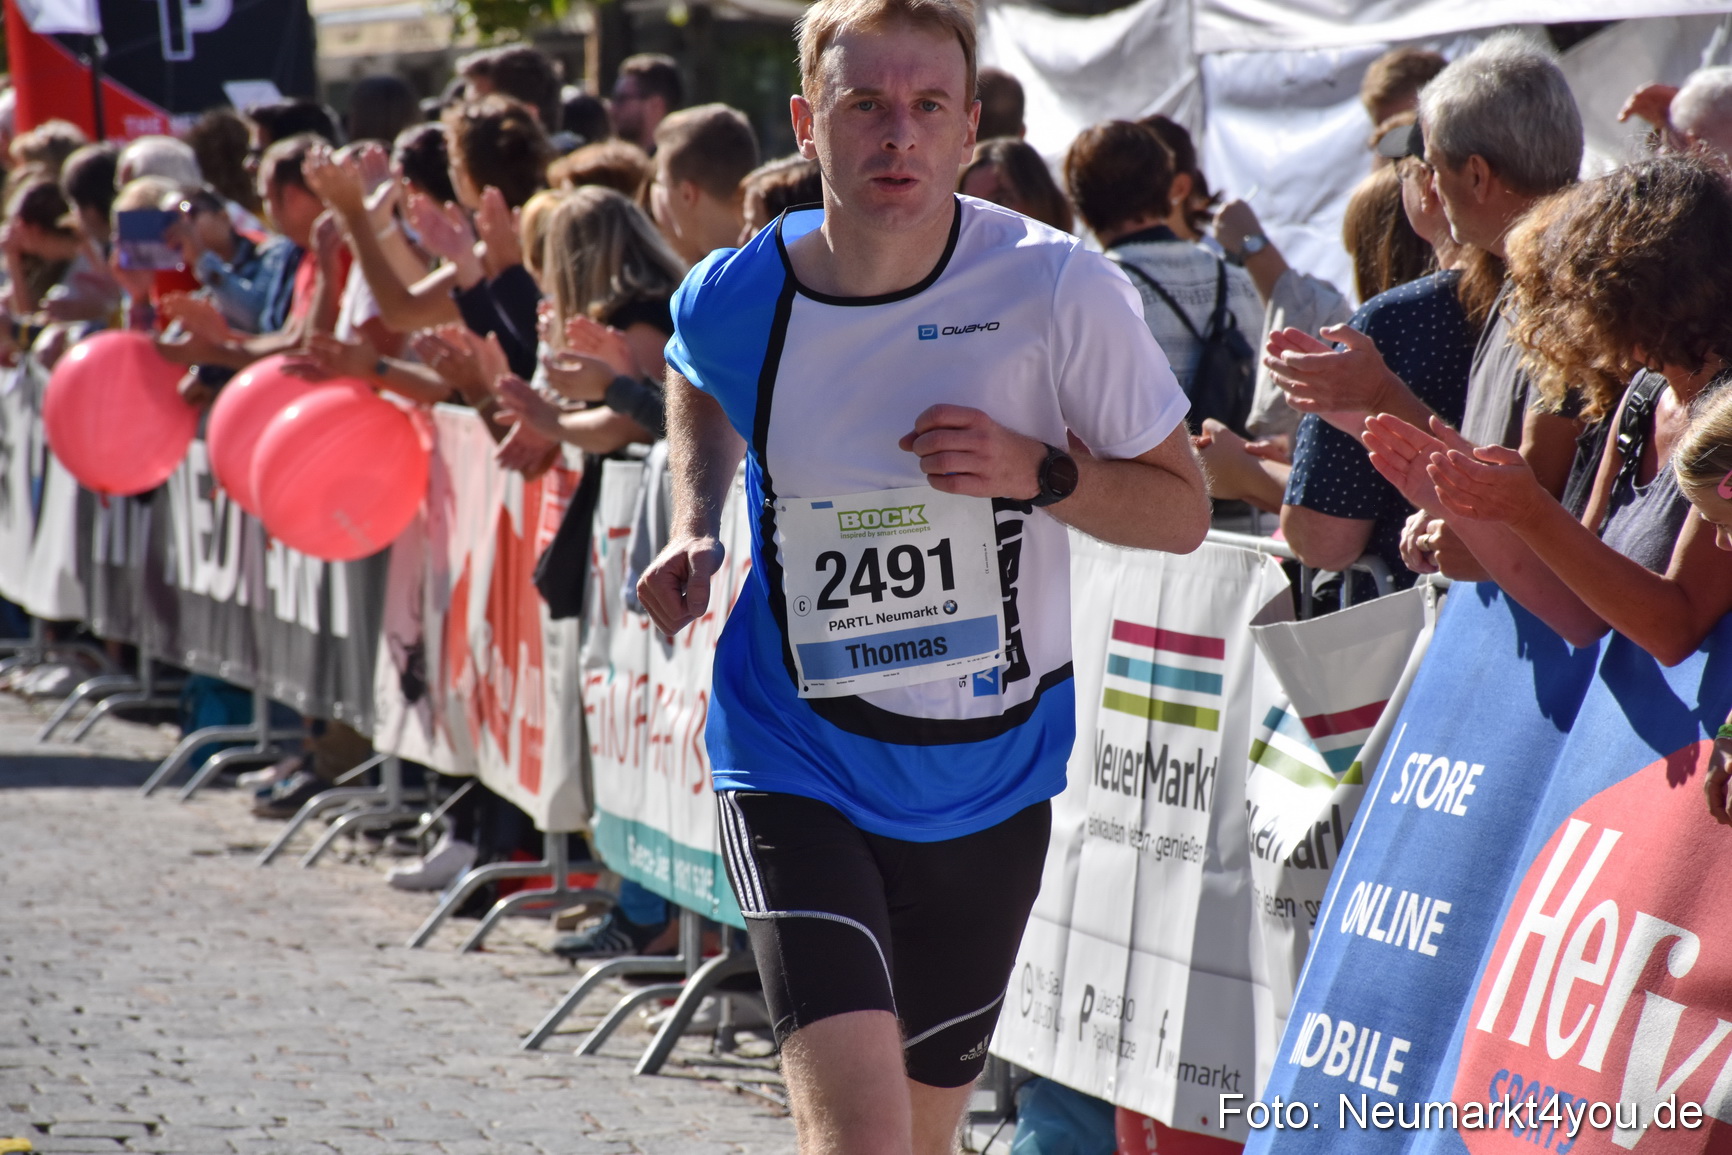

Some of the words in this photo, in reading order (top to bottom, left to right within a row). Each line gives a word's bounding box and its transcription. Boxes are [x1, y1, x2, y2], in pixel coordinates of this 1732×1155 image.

[837, 504, 929, 532] BOCK
[840, 531, 867, 540] inspired
[868, 530, 876, 538] by
[876, 529, 897, 537] smart
[898, 525, 931, 535] concepts
[815, 537, 955, 611] 2491
[828, 615, 874, 632] PARTL
[876, 605, 939, 624] Neumarkt
[845, 636, 948, 669] Thomas
[1390, 752, 1485, 817] STORE
[1340, 880, 1452, 957] ONLINE
[1288, 1012, 1412, 1098] MOBILE
